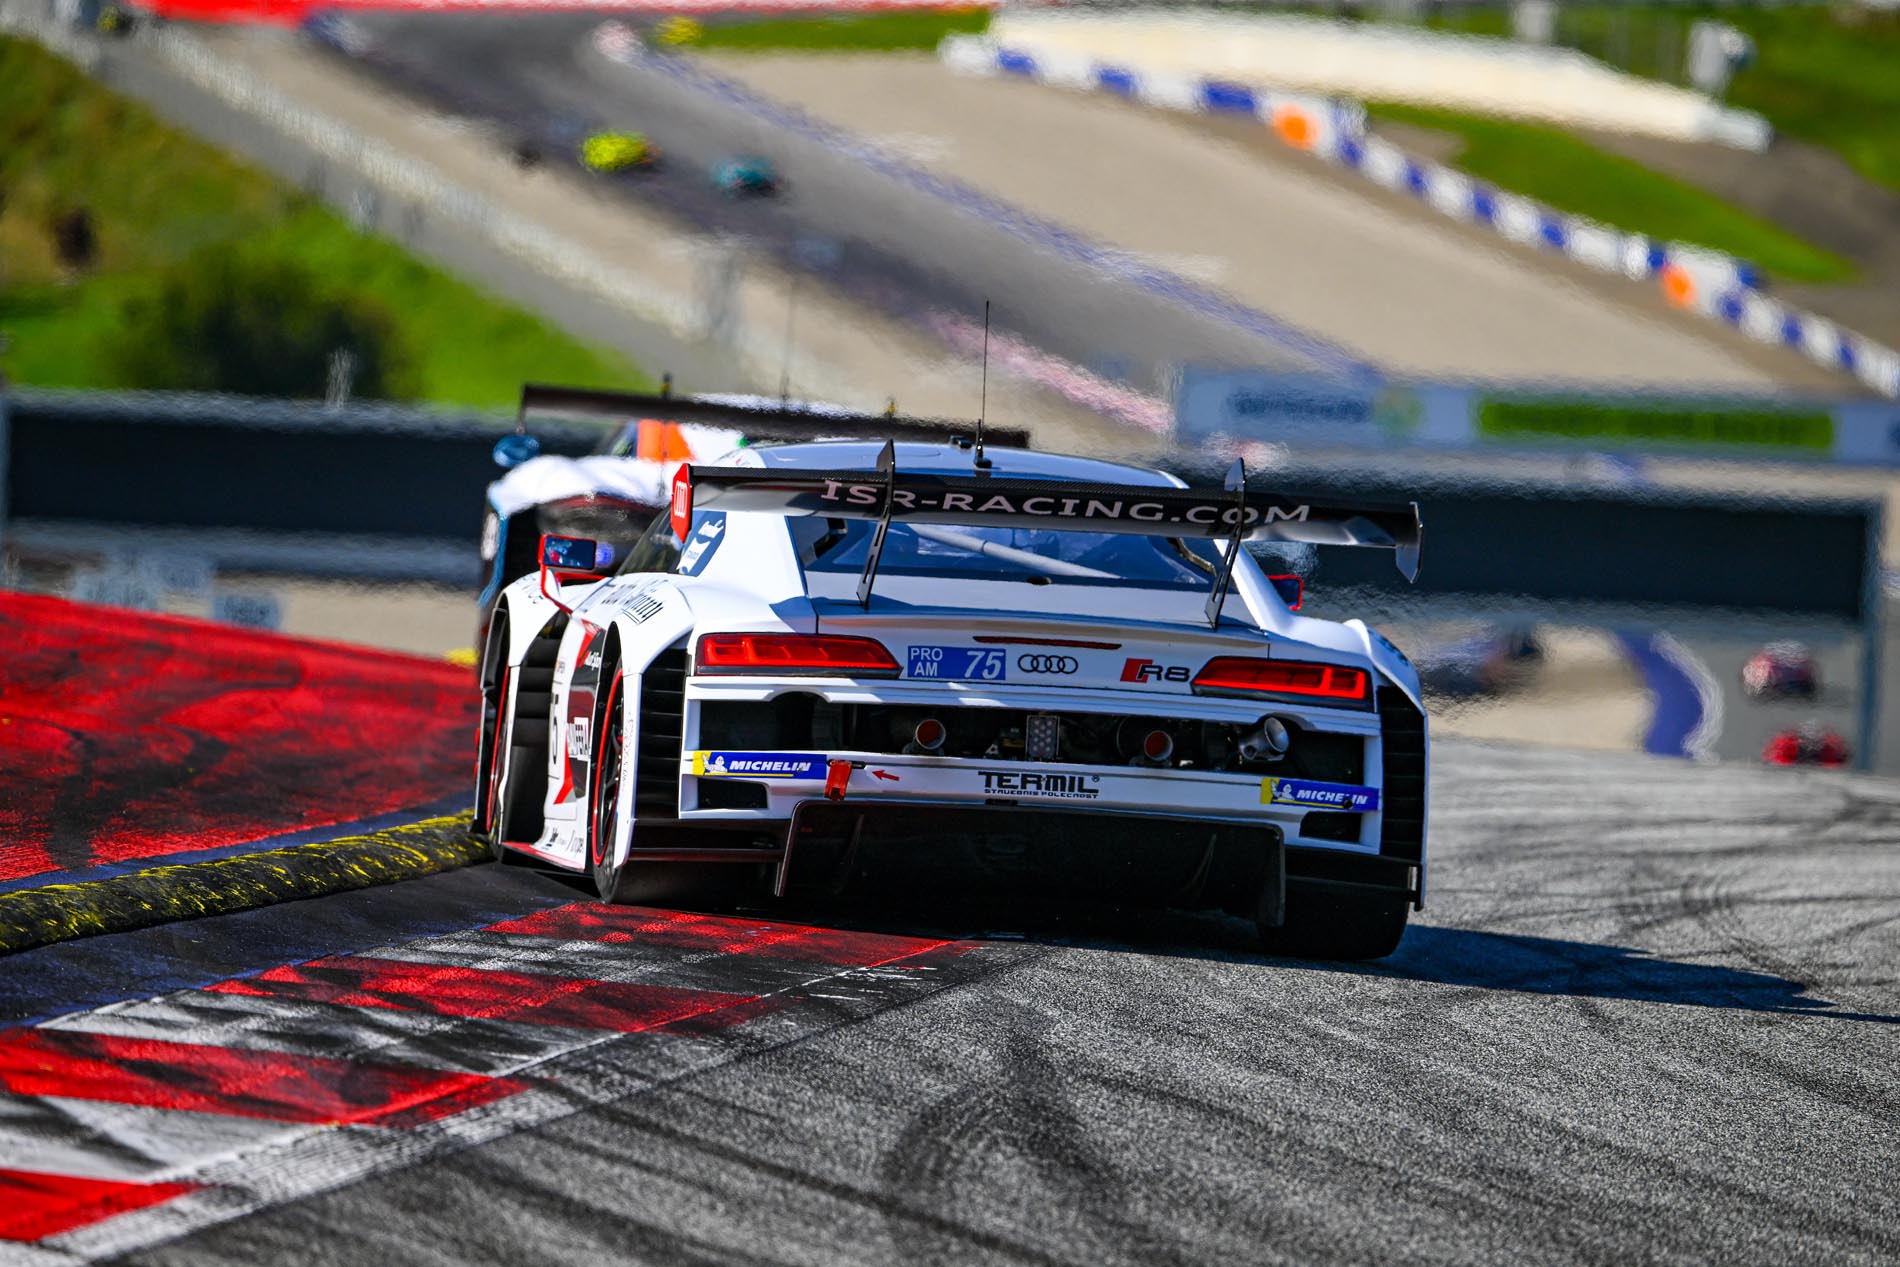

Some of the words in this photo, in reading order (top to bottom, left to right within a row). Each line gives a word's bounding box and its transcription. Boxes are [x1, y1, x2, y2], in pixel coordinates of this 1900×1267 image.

[820, 479, 1310, 524] ISR-RACING.COM
[910, 647, 943, 661] PRO
[914, 663, 938, 678] AM
[963, 651, 1005, 680] 75
[1137, 664, 1191, 682] R8
[729, 760, 812, 772] MICHELIN
[1296, 789, 1368, 805] MICHEIN
